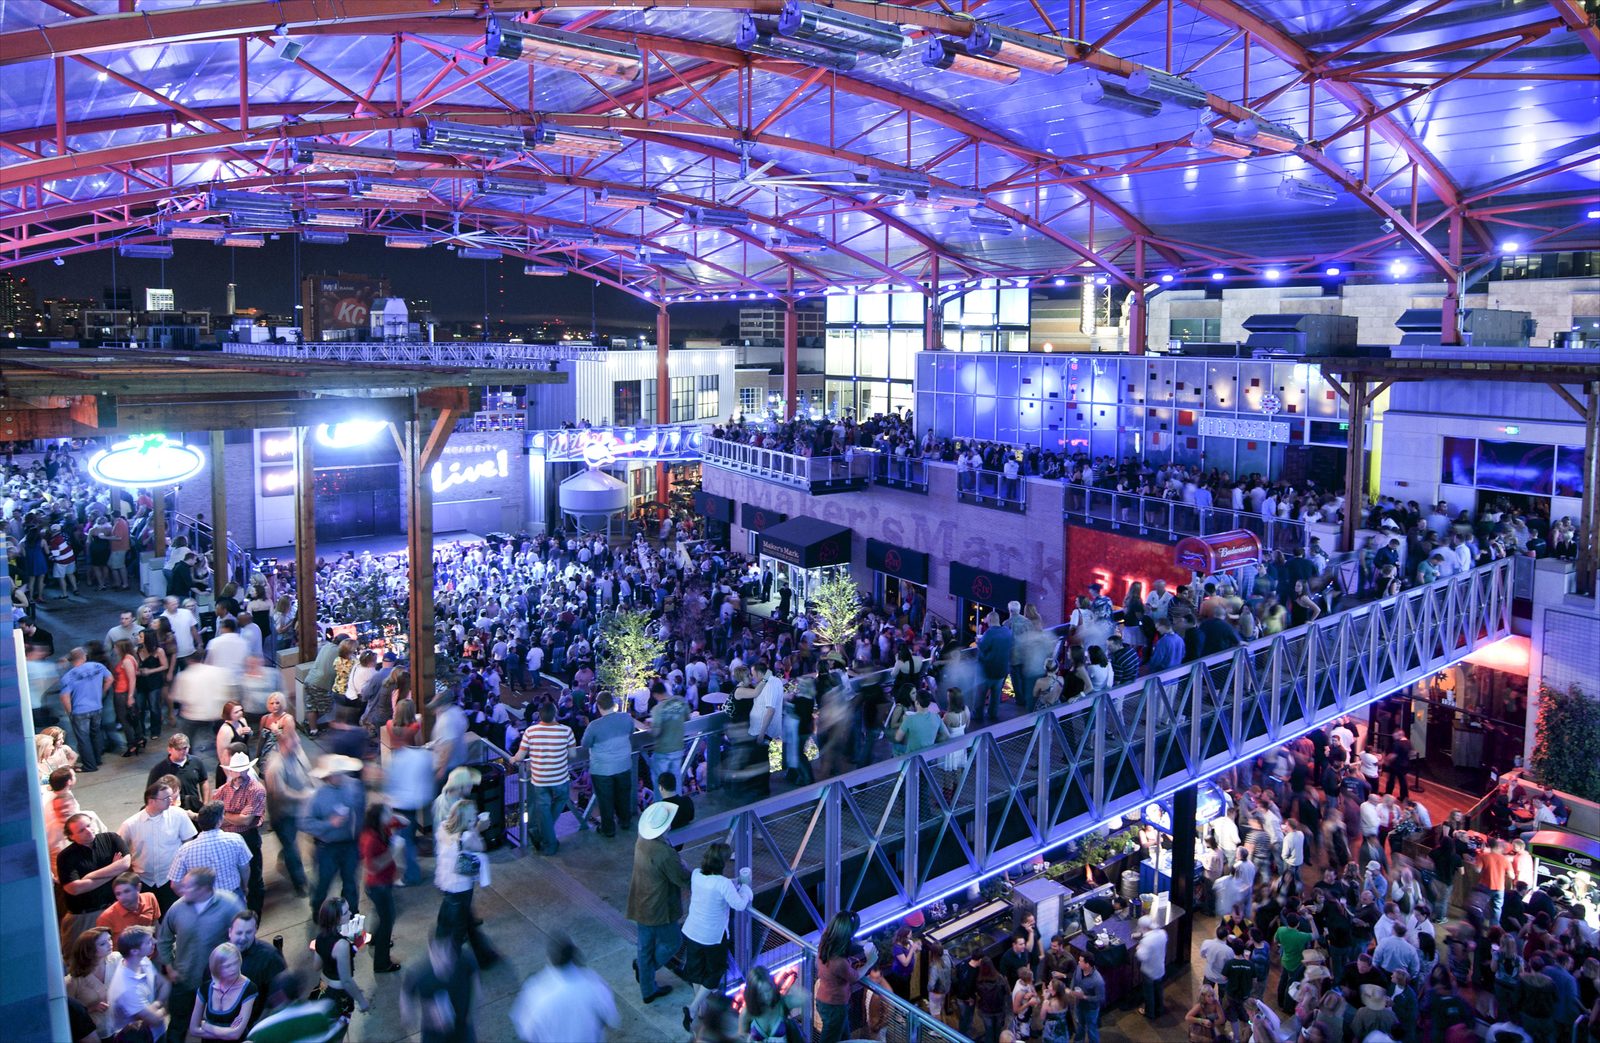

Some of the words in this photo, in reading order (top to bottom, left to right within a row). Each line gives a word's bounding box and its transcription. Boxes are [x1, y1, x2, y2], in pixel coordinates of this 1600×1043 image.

[337, 301, 367, 325] KC
[430, 448, 509, 493] Live!
[762, 540, 784, 553] Maker's
[783, 546, 800, 559] Mark
[911, 512, 1063, 597] Mark
[1218, 545, 1254, 558] Budweiser
